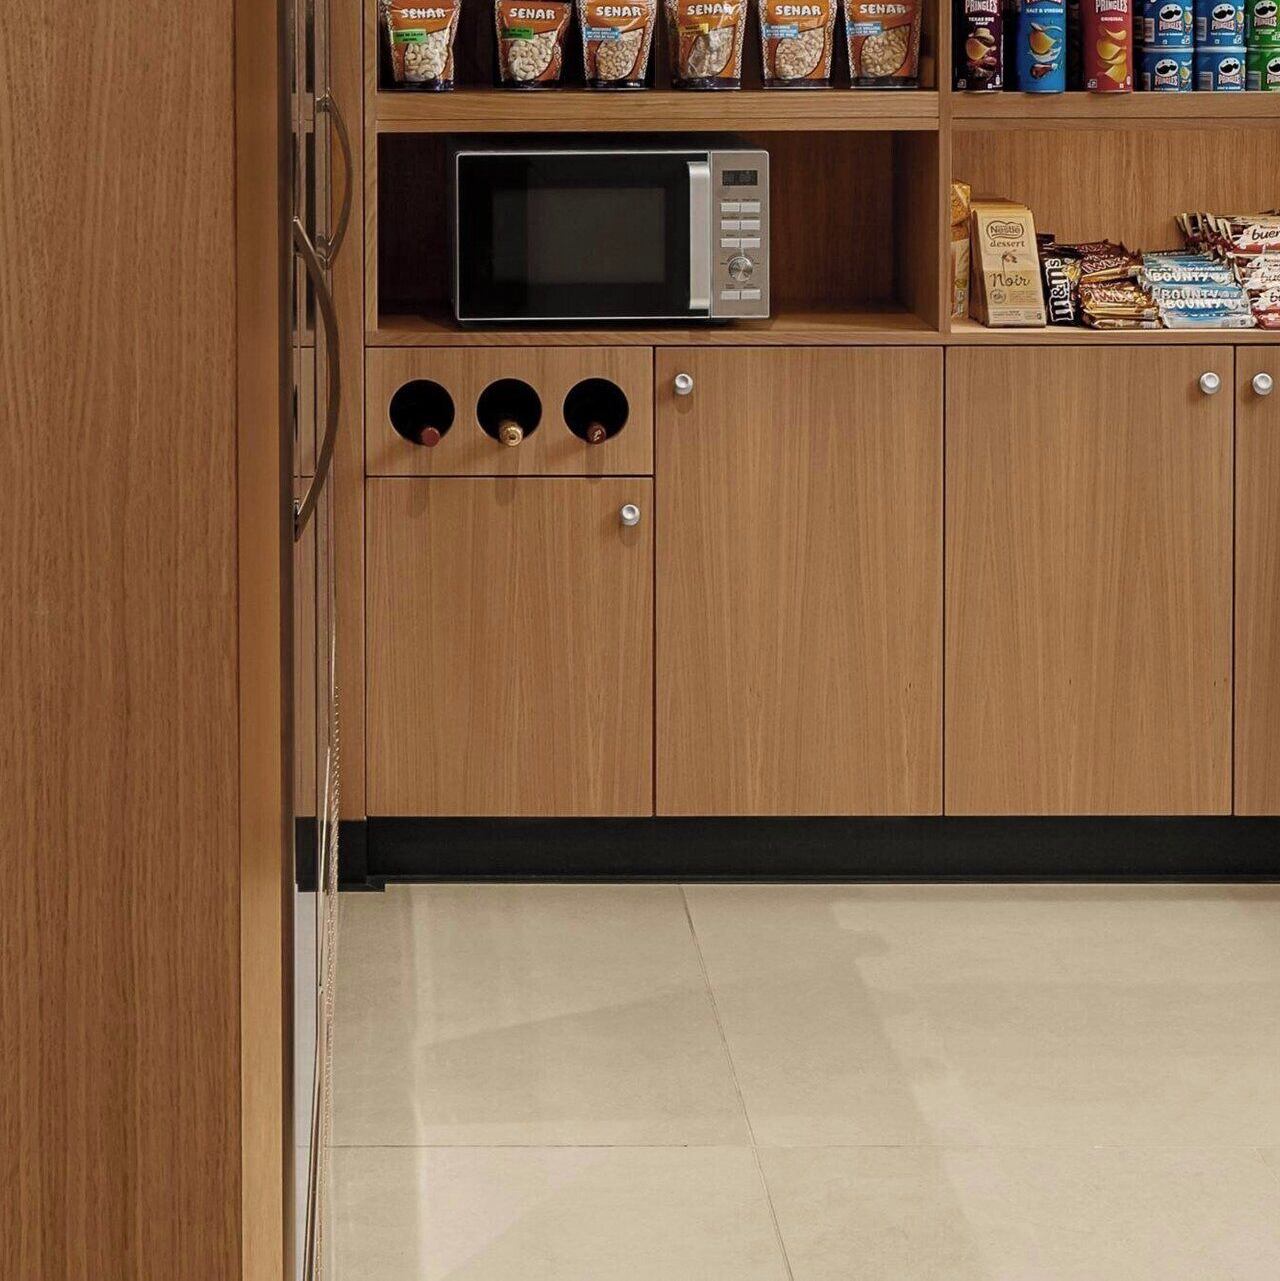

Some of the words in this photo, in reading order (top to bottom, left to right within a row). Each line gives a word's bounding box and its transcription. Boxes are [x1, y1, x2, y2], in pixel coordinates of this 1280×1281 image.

[401, 8, 446, 19] SENAR
[509, 8, 556, 20] SENAR
[596, 6, 642, 17] SENAR
[687, 3, 732, 16] SENAR
[775, 4, 821, 16] SENAR
[859, 4, 906, 15] SENAR
[990, 240, 1025, 248] dessert
[990, 273, 1030, 288] Noir
[1153, 272, 1208, 282] BOUNTY
[1162, 290, 1218, 298] BOUNTY
